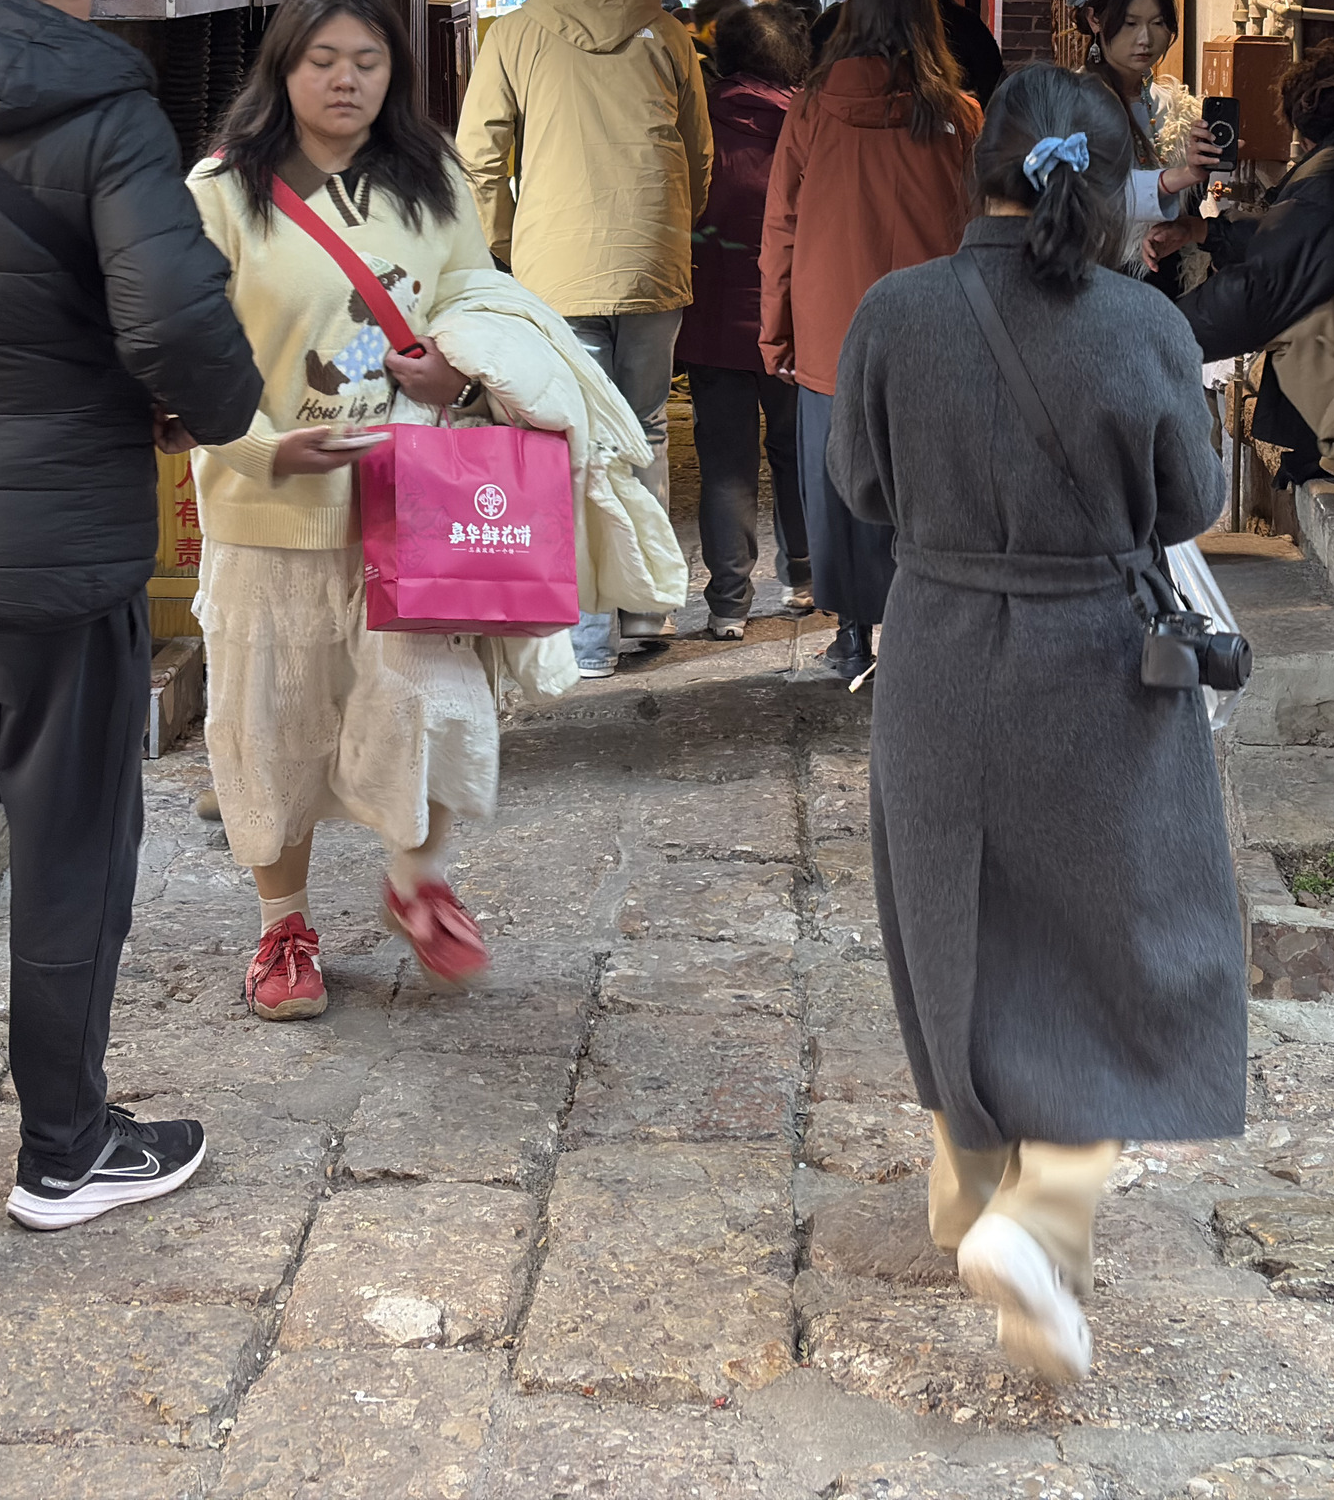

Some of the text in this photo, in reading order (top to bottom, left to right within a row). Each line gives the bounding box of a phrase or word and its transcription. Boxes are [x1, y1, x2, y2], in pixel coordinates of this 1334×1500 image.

[296, 398, 343, 421] How
[448, 521, 532, 547] 嘉华鲜花饼
